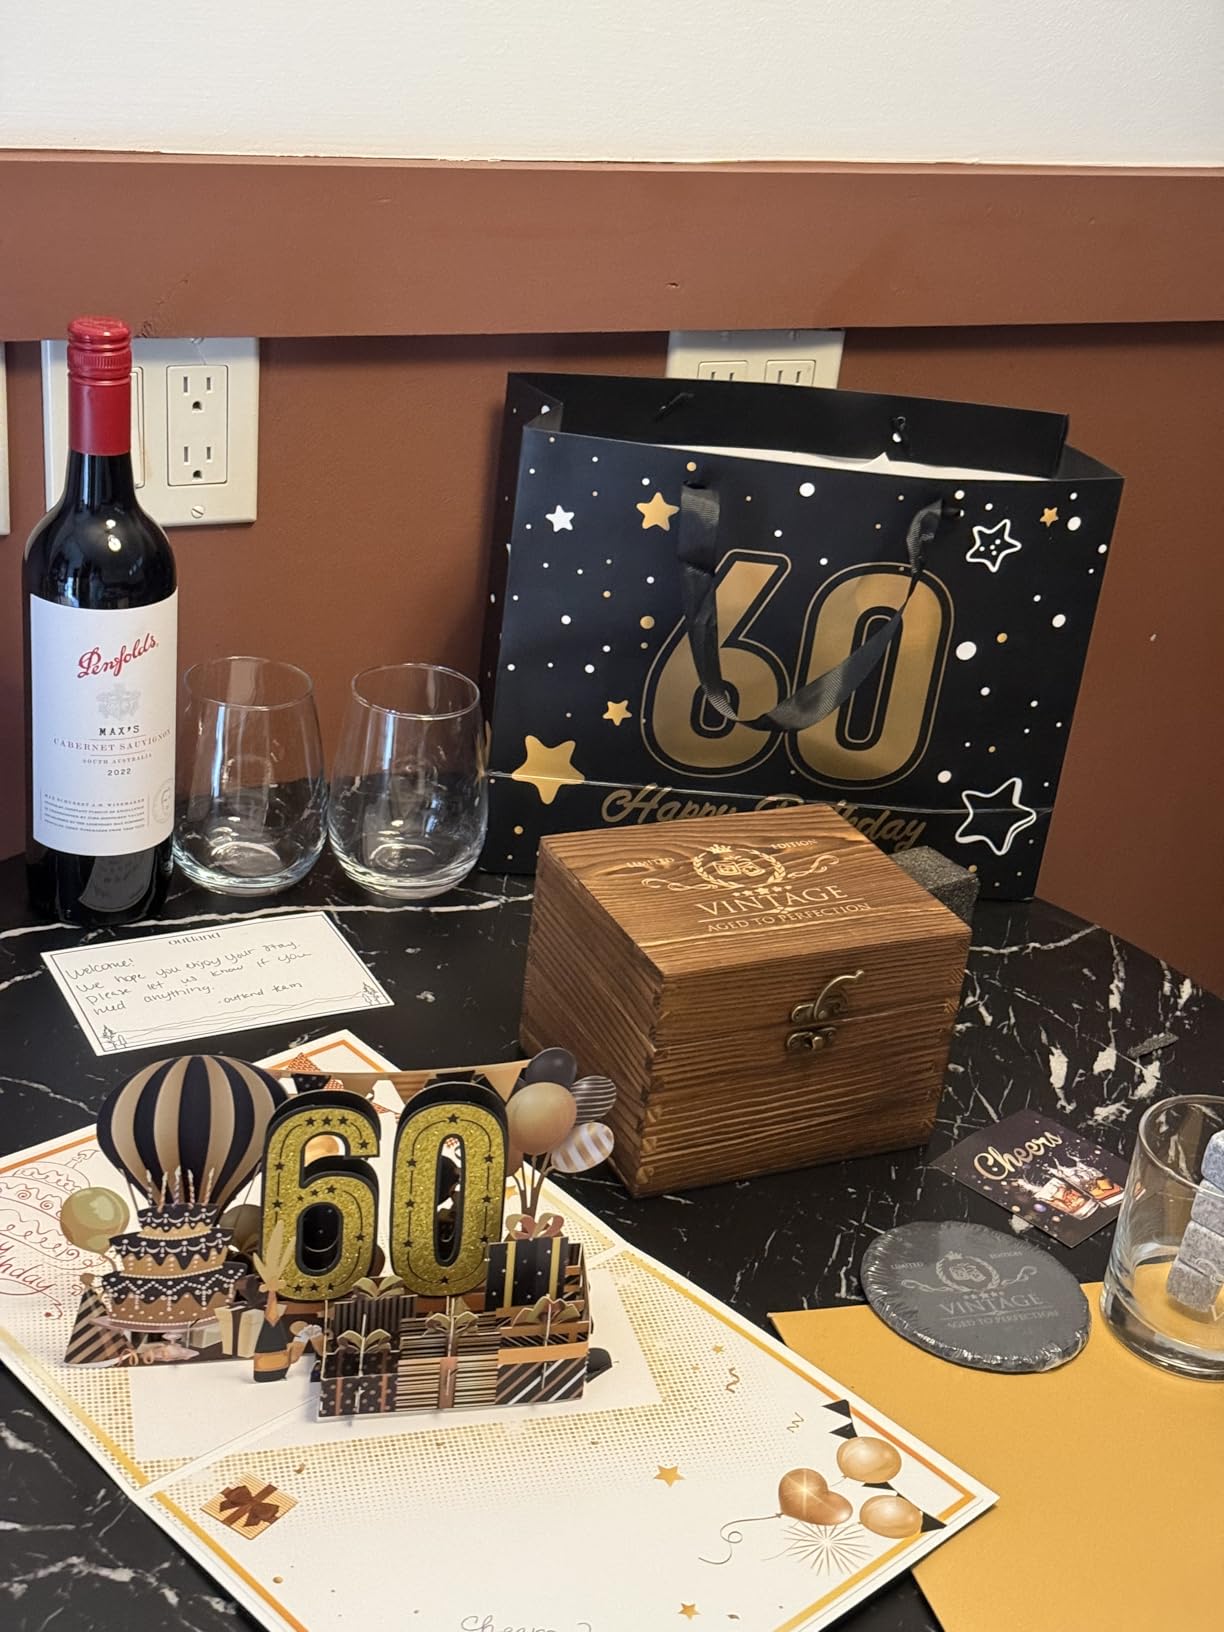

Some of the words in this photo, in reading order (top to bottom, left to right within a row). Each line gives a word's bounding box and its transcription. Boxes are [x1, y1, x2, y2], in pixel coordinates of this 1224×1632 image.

[77, 633, 156, 678] Penfolds
[641, 549, 954, 790] 60
[99, 725, 140, 736] MAX'S
[53, 738, 115, 751] CABERNET
[107, 768, 131, 776] 2022
[771, 838, 817, 850] EDITION
[696, 885, 849, 916] VINTAGE
[708, 919, 749, 932] AGED
[751, 915, 775, 926] TO
[778, 902, 871, 922] PERFECTION
[65, 958, 134, 980] Welcome!
[114, 974, 146, 983] hope
[186, 957, 222, 970] enjoy
[147, 981, 165, 991] let
[180, 976, 198, 984] us
[278, 952, 312, 964] you
[93, 1000, 126, 1016] need
[973, 1131, 1063, 1180] Cheers
[262, 1101, 506, 1301] 60
[939, 1293, 1043, 1315] VINTAGE
